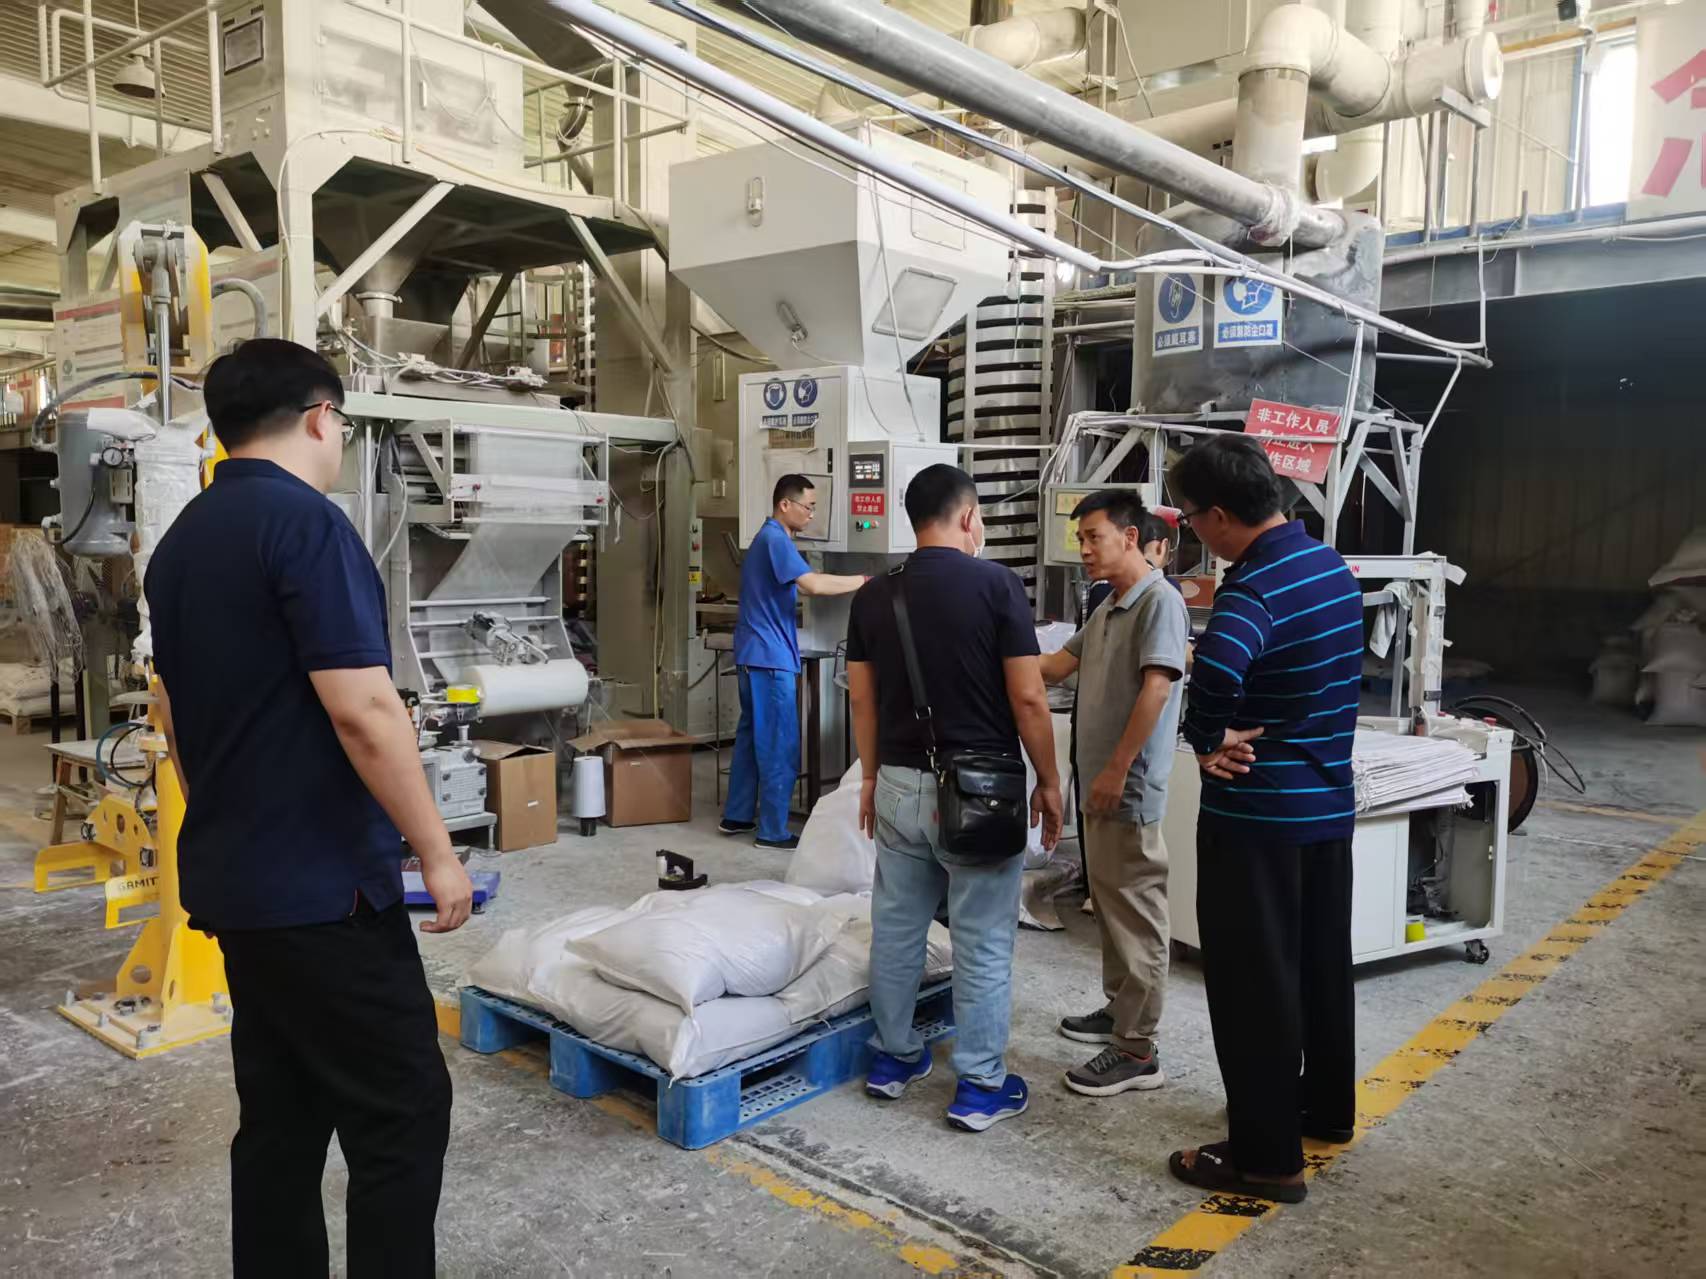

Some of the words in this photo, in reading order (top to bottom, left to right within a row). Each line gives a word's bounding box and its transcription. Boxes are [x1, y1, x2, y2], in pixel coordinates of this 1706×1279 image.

[1256, 407, 1330, 435] 非工作人员
[1266, 450, 1313, 473] 作区域
